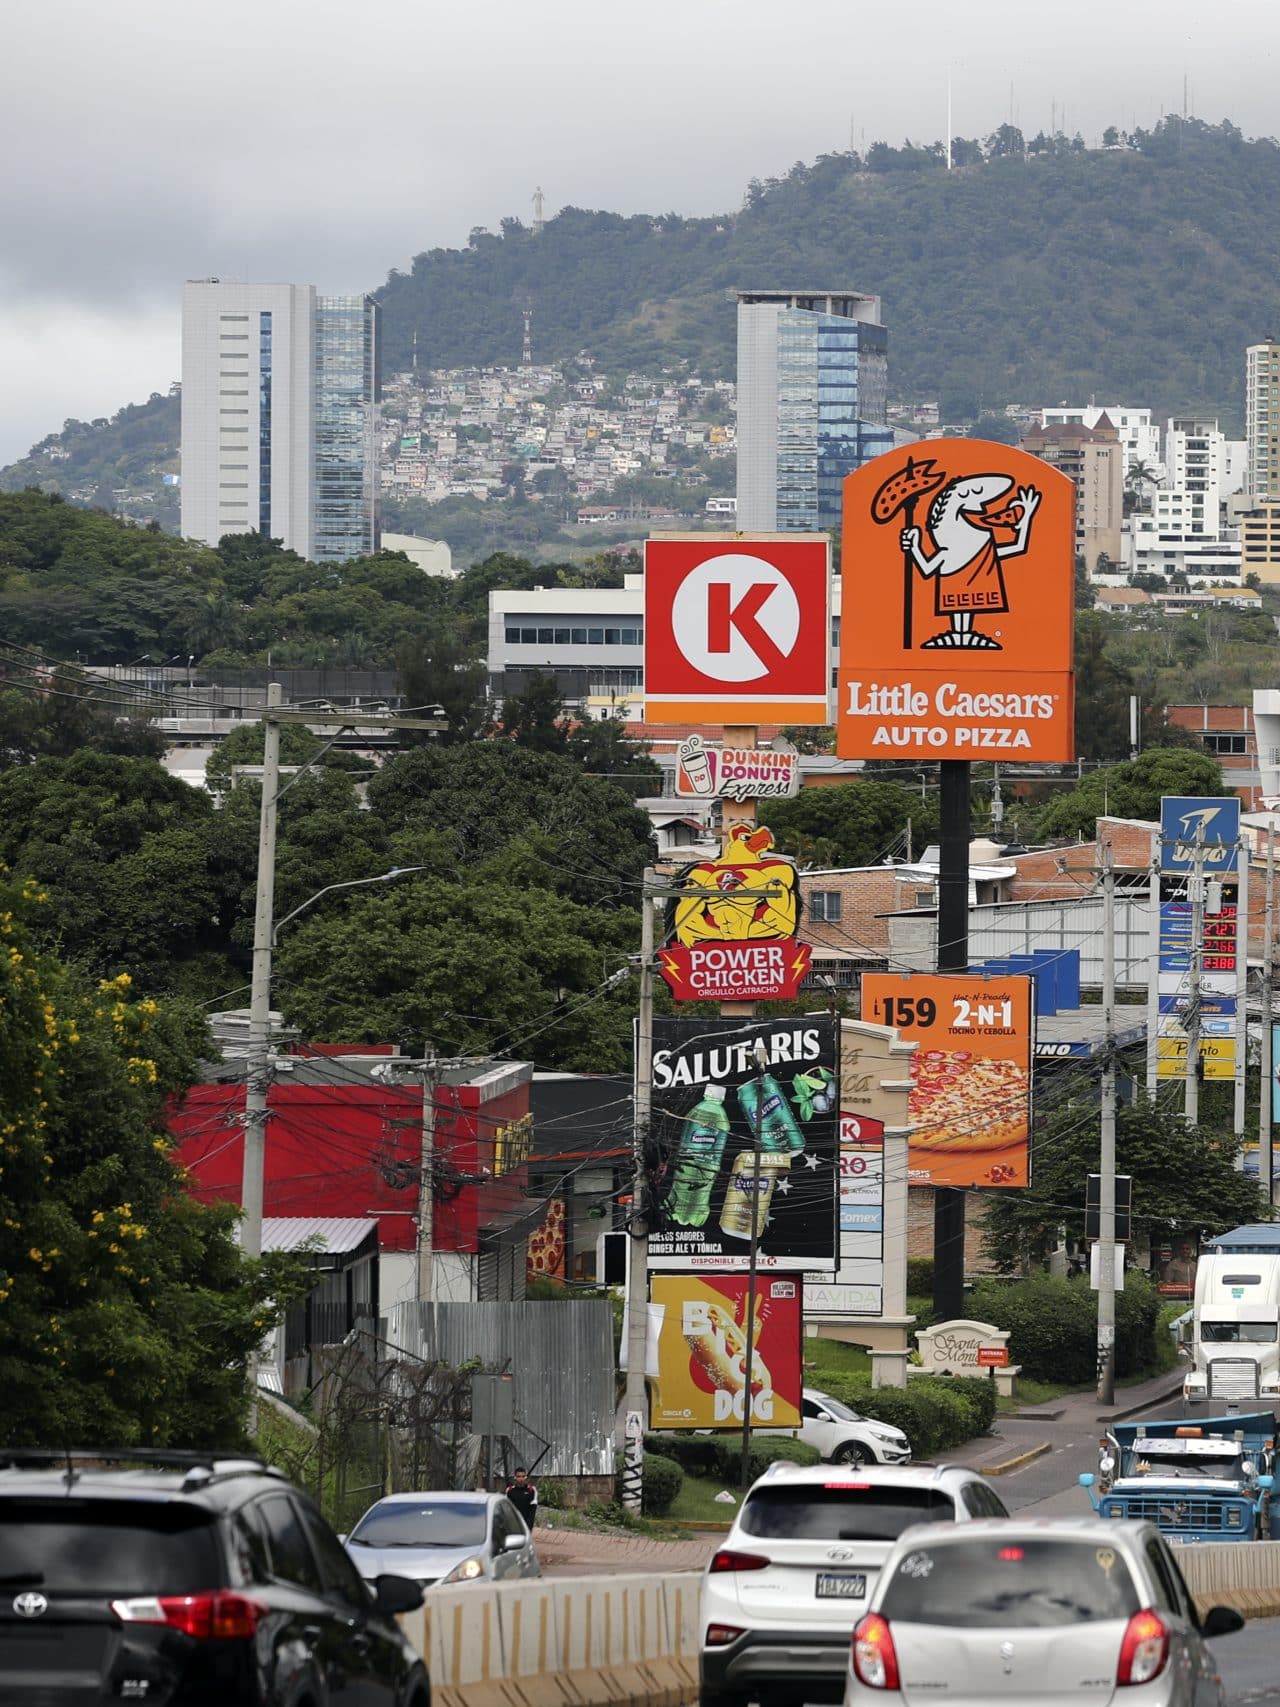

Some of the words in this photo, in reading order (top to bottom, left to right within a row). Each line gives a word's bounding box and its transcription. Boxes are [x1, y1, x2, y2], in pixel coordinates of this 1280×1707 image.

[707, 583, 790, 674] K
[846, 682, 928, 717] Little
[935, 683, 1053, 719] Caesars
[872, 727, 948, 747] AUTO
[955, 728, 1032, 748] PIZZA
[721, 750, 797, 768] DUNKIN'
[721, 765, 792, 782] DONUTS
[718, 778, 791, 800] Express
[690, 946, 785, 971] POWER
[689, 967, 786, 989] CHICKEN
[697, 988, 735, 997] ORGULLO
[736, 986, 779, 995] CATRACHO
[882, 997, 937, 1028] 159
[952, 999, 1013, 1028] 2-N-1
[948, 1027, 976, 1036] TOCINO
[977, 1027, 983, 1036] Y
[983, 1027, 1017, 1037] CEBOLLA
[1174, 1041, 1219, 1056] Pnto
[652, 1028, 821, 1090] SALUTARIS
[842, 1123, 859, 1139] K
[840, 1211, 881, 1224] Comex
[675, 1231, 705, 1242] SABORES
[648, 1243, 674, 1254] GINGER
[675, 1243, 690, 1254] ALE
[690, 1243, 696, 1254] Y
[696, 1241, 723, 1254] TÓNICA
[690, 1257, 735, 1265] DISPONIBLE
[932, 1334, 983, 1350] Santa
[714, 1389, 774, 1421] DOG
